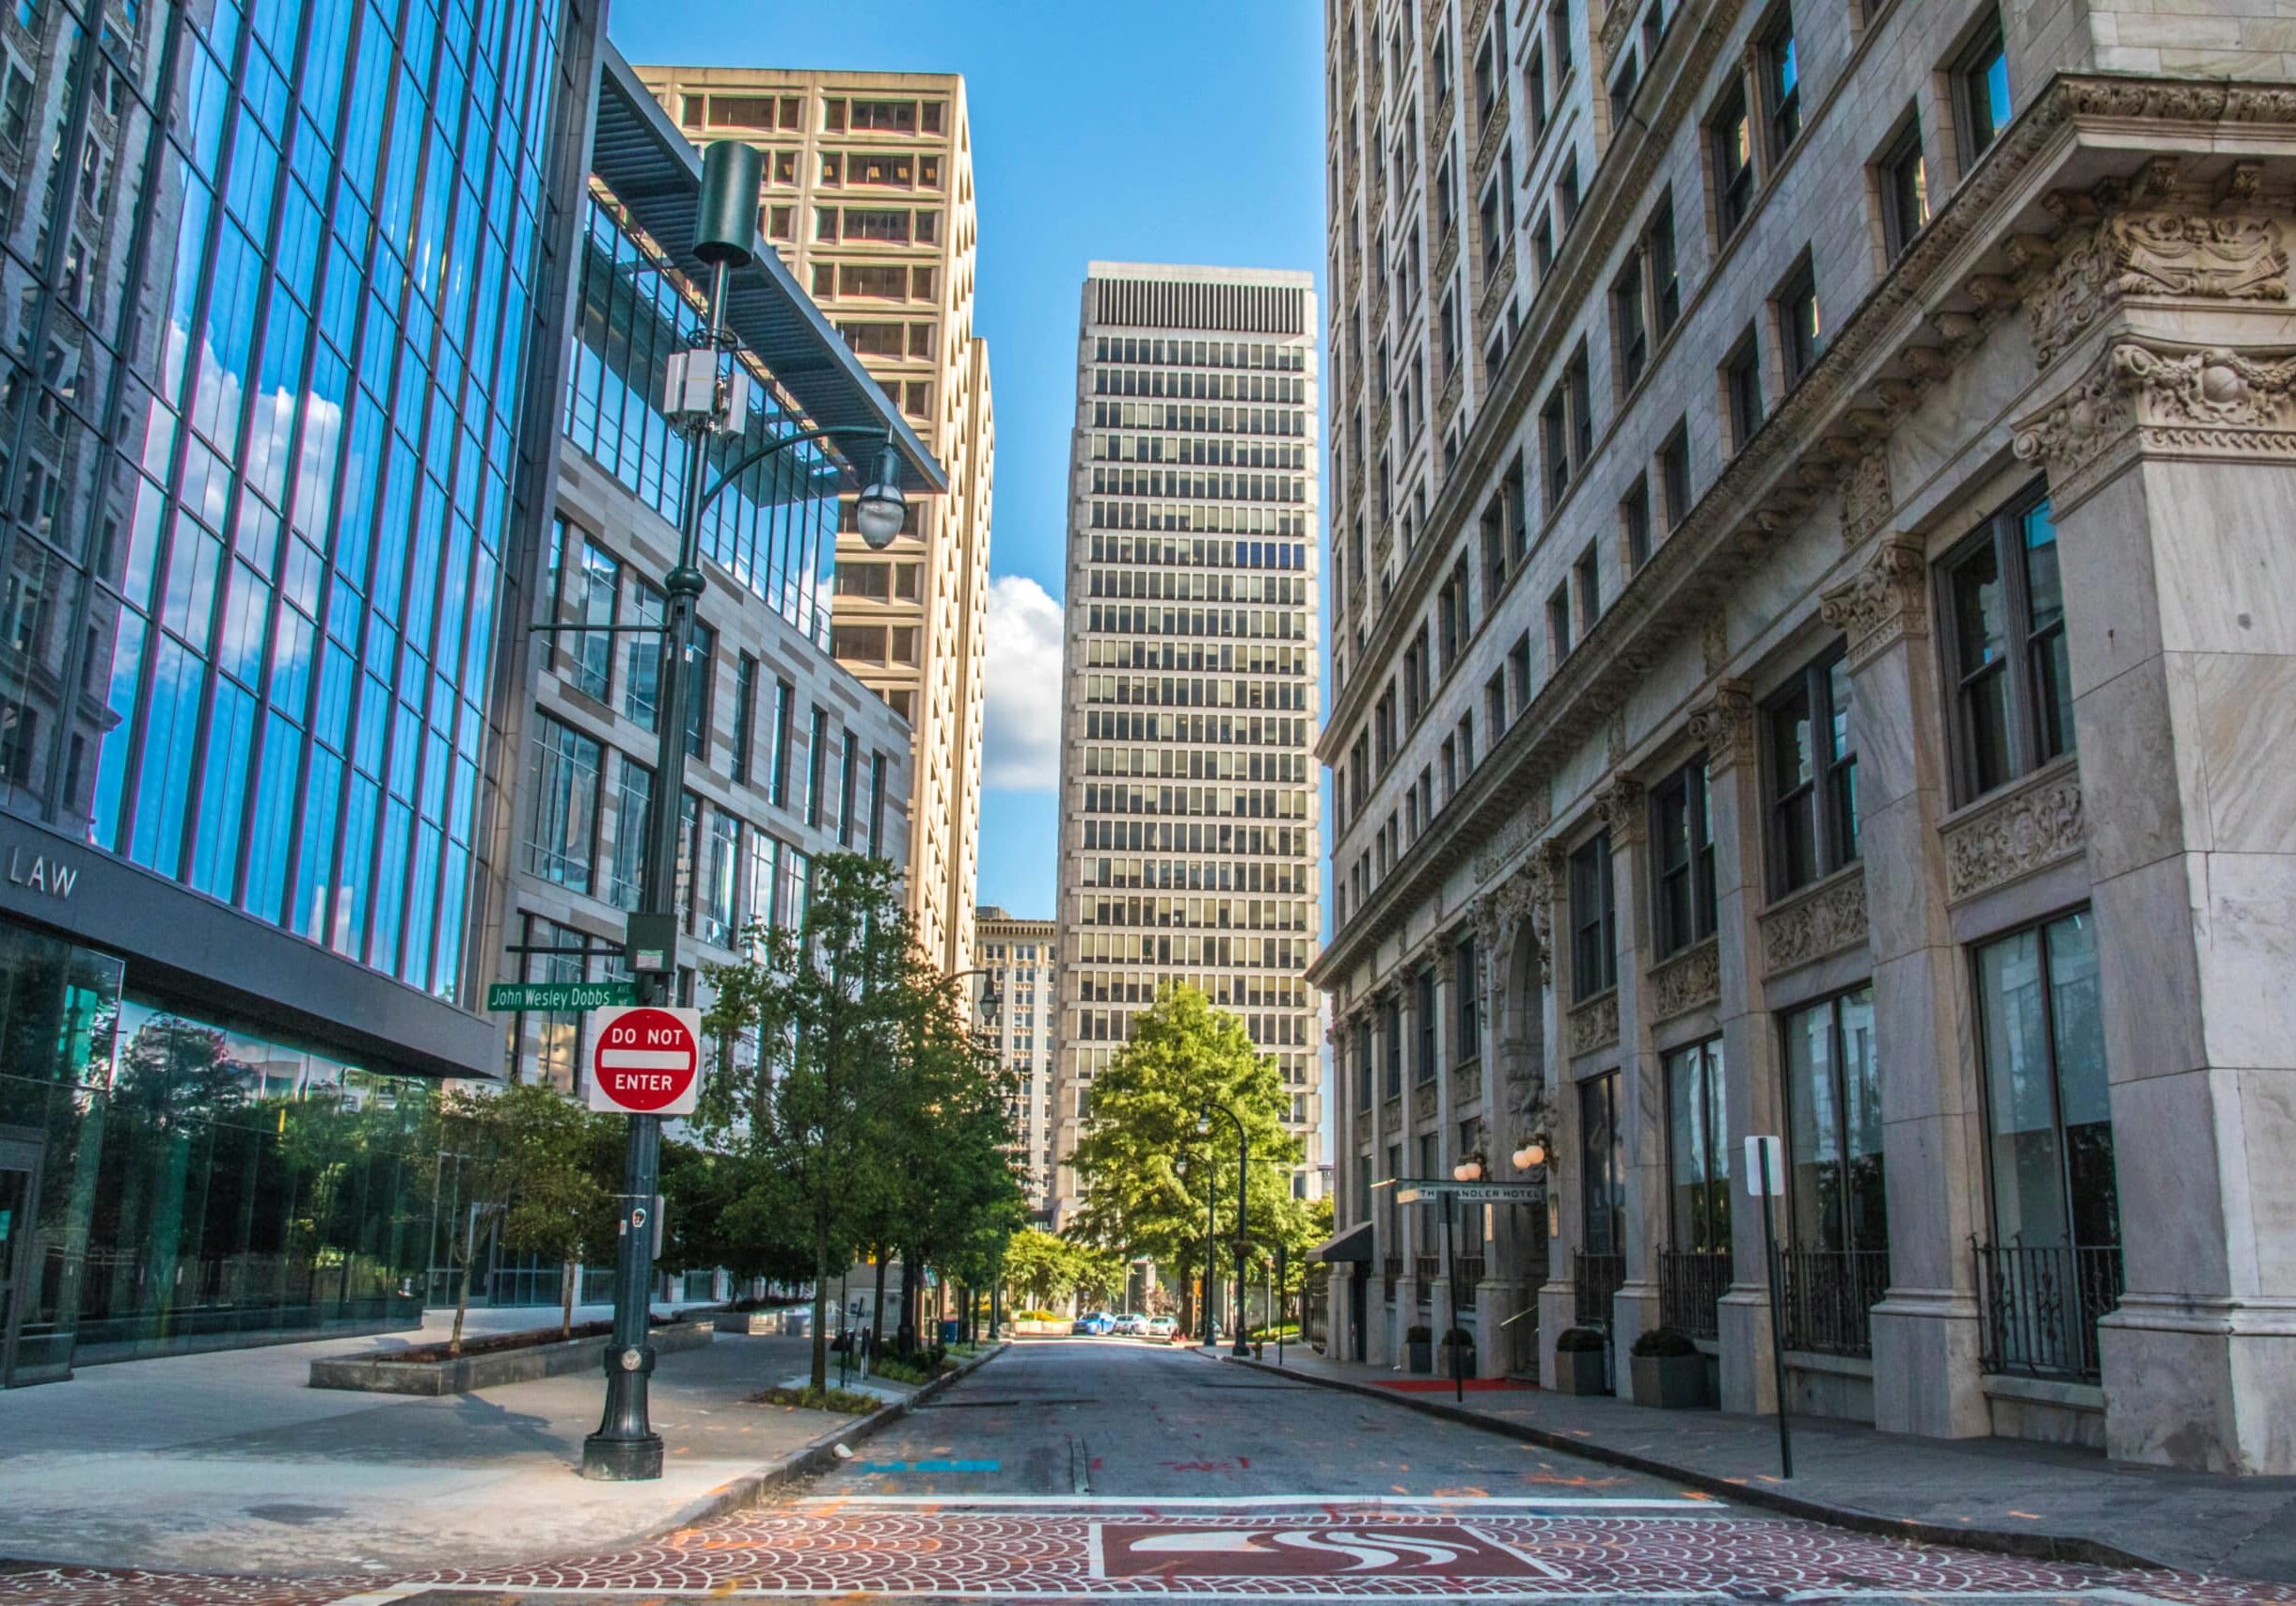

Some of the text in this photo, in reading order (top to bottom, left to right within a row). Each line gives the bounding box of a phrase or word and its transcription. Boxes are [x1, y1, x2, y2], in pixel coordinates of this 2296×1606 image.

[9, 847, 77, 898] LAW
[492, 988, 610, 1010] John Wesley Dobbs
[611, 1028, 683, 1045] DO NOT
[615, 1073, 673, 1090] ENTER
[1420, 1189, 1435, 1198] TH
[1503, 1189, 1540, 1198] HOTEL
